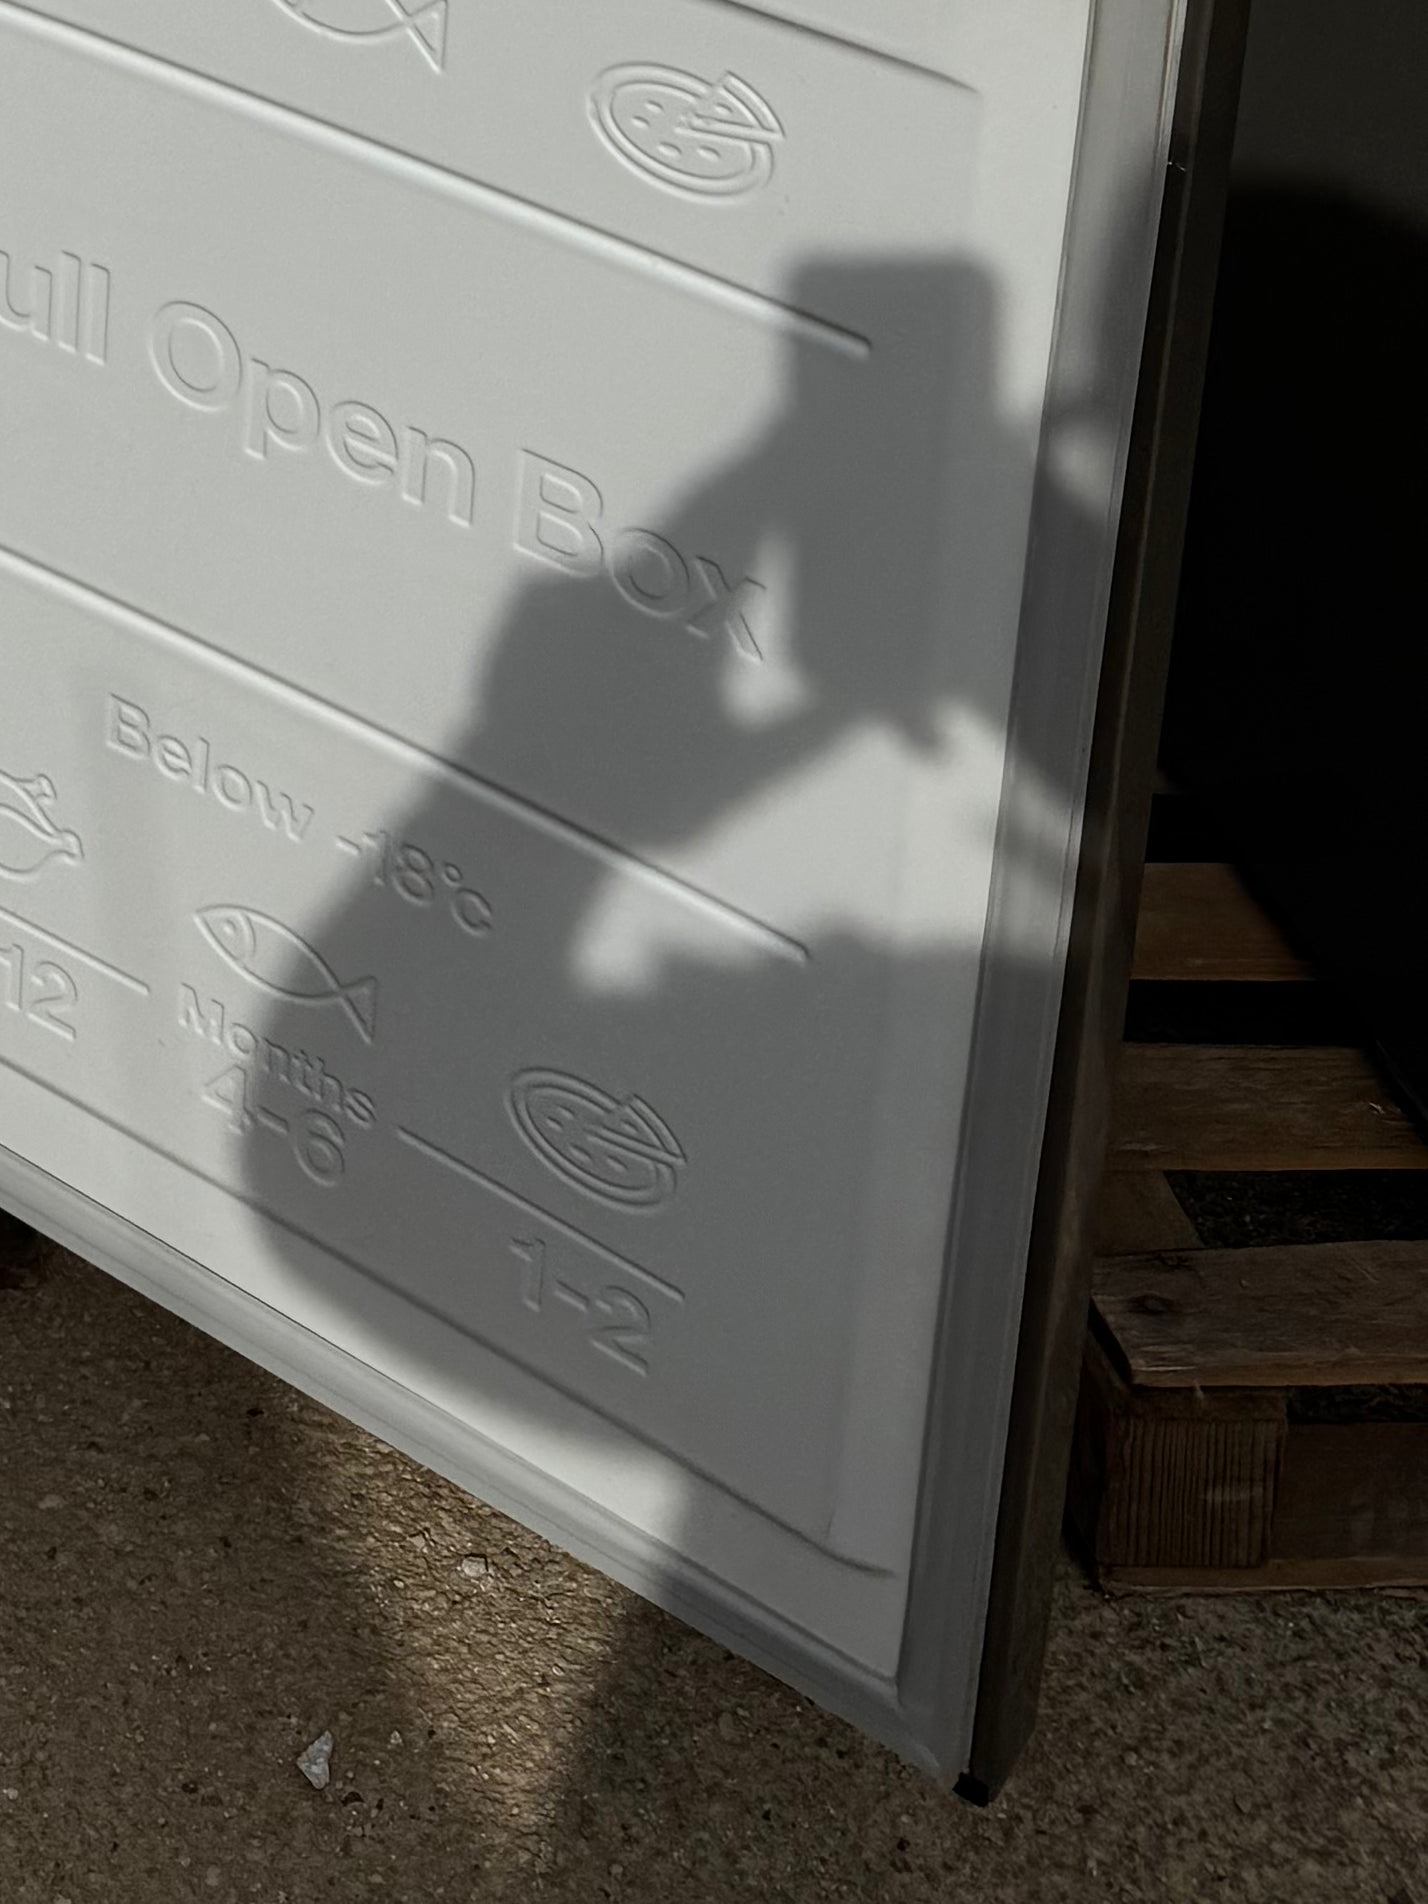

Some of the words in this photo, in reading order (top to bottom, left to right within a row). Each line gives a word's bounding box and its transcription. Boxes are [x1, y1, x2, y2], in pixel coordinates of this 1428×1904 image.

[147, 298, 477, 528] Open
[510, 446, 768, 664] Box
[102, 692, 314, 843] Below
[174, 980, 379, 1132] Months
[200, 1060, 350, 1189] 4-6
[507, 1234, 654, 1378] 1-2
